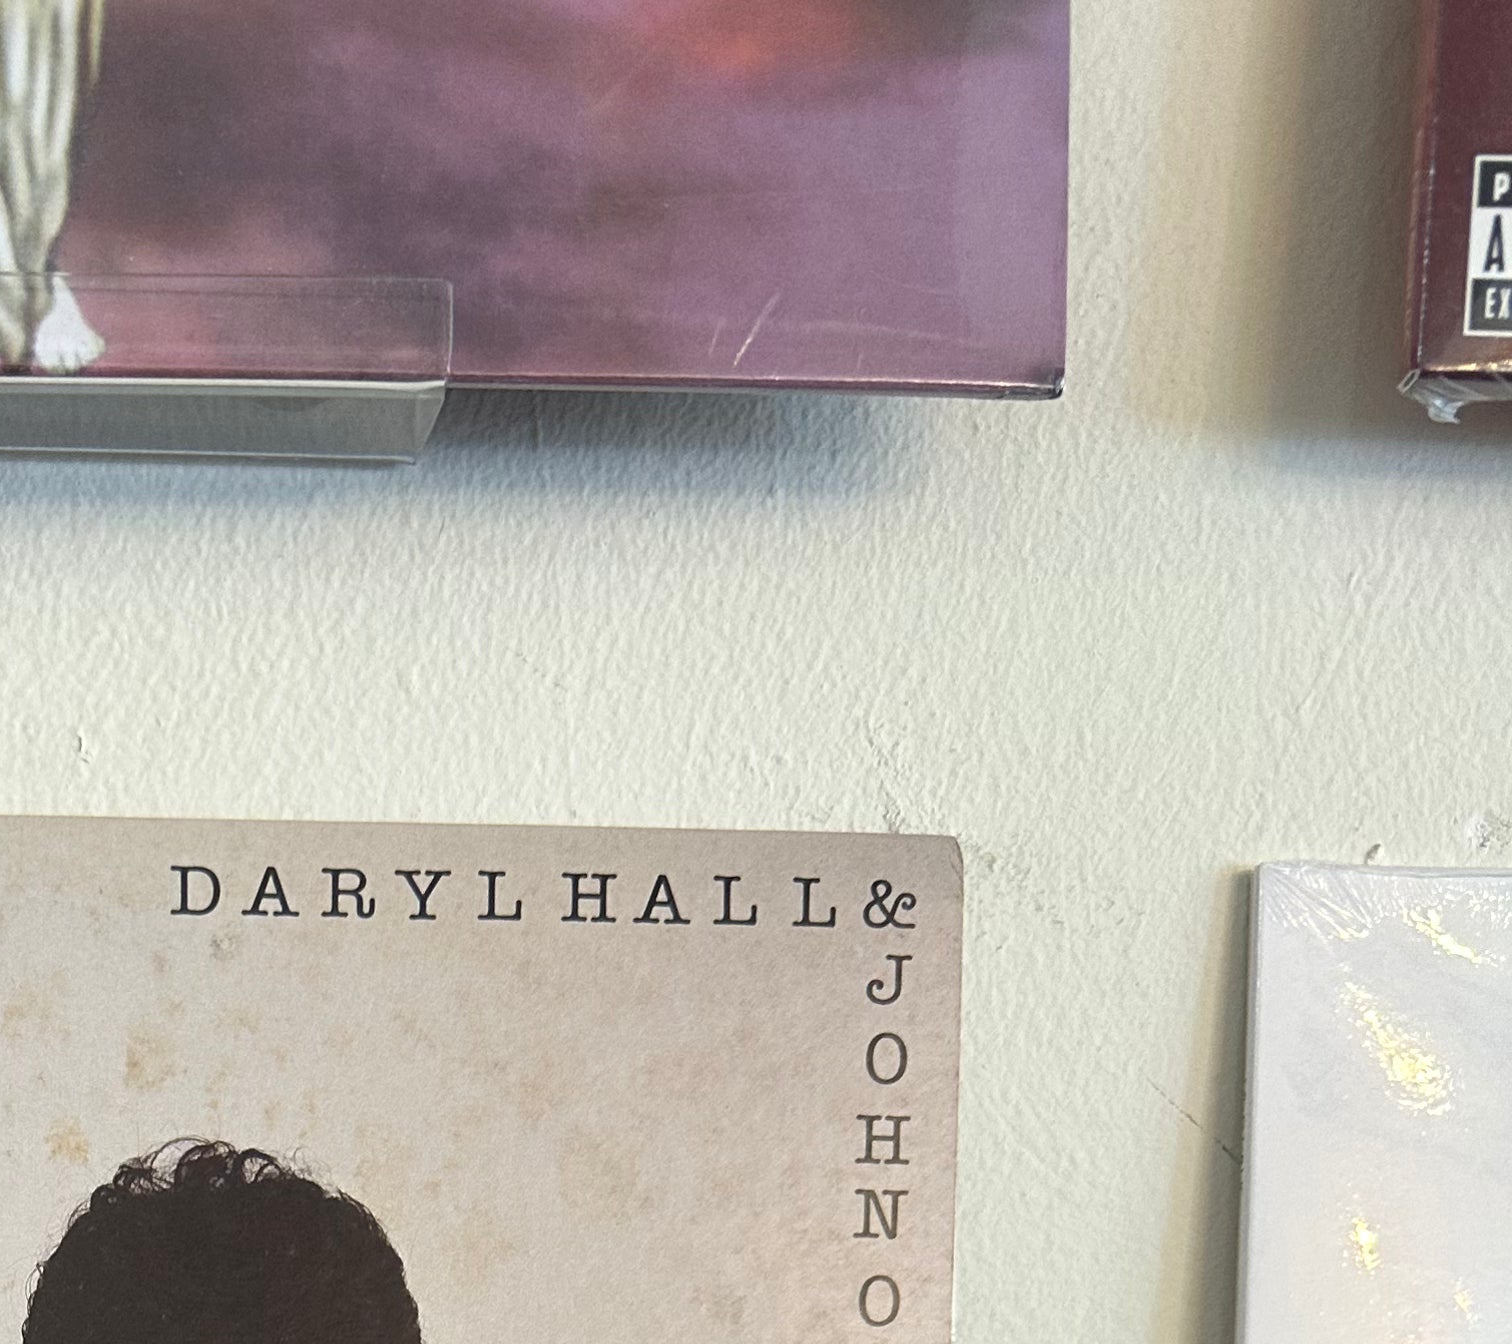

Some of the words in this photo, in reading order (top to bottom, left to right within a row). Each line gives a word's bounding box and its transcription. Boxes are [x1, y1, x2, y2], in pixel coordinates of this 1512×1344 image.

[170, 865, 522, 922] DARYL
[560, 871, 838, 929] HALL
[862, 879, 918, 930] &
[854, 954, 914, 1241] JOHN
